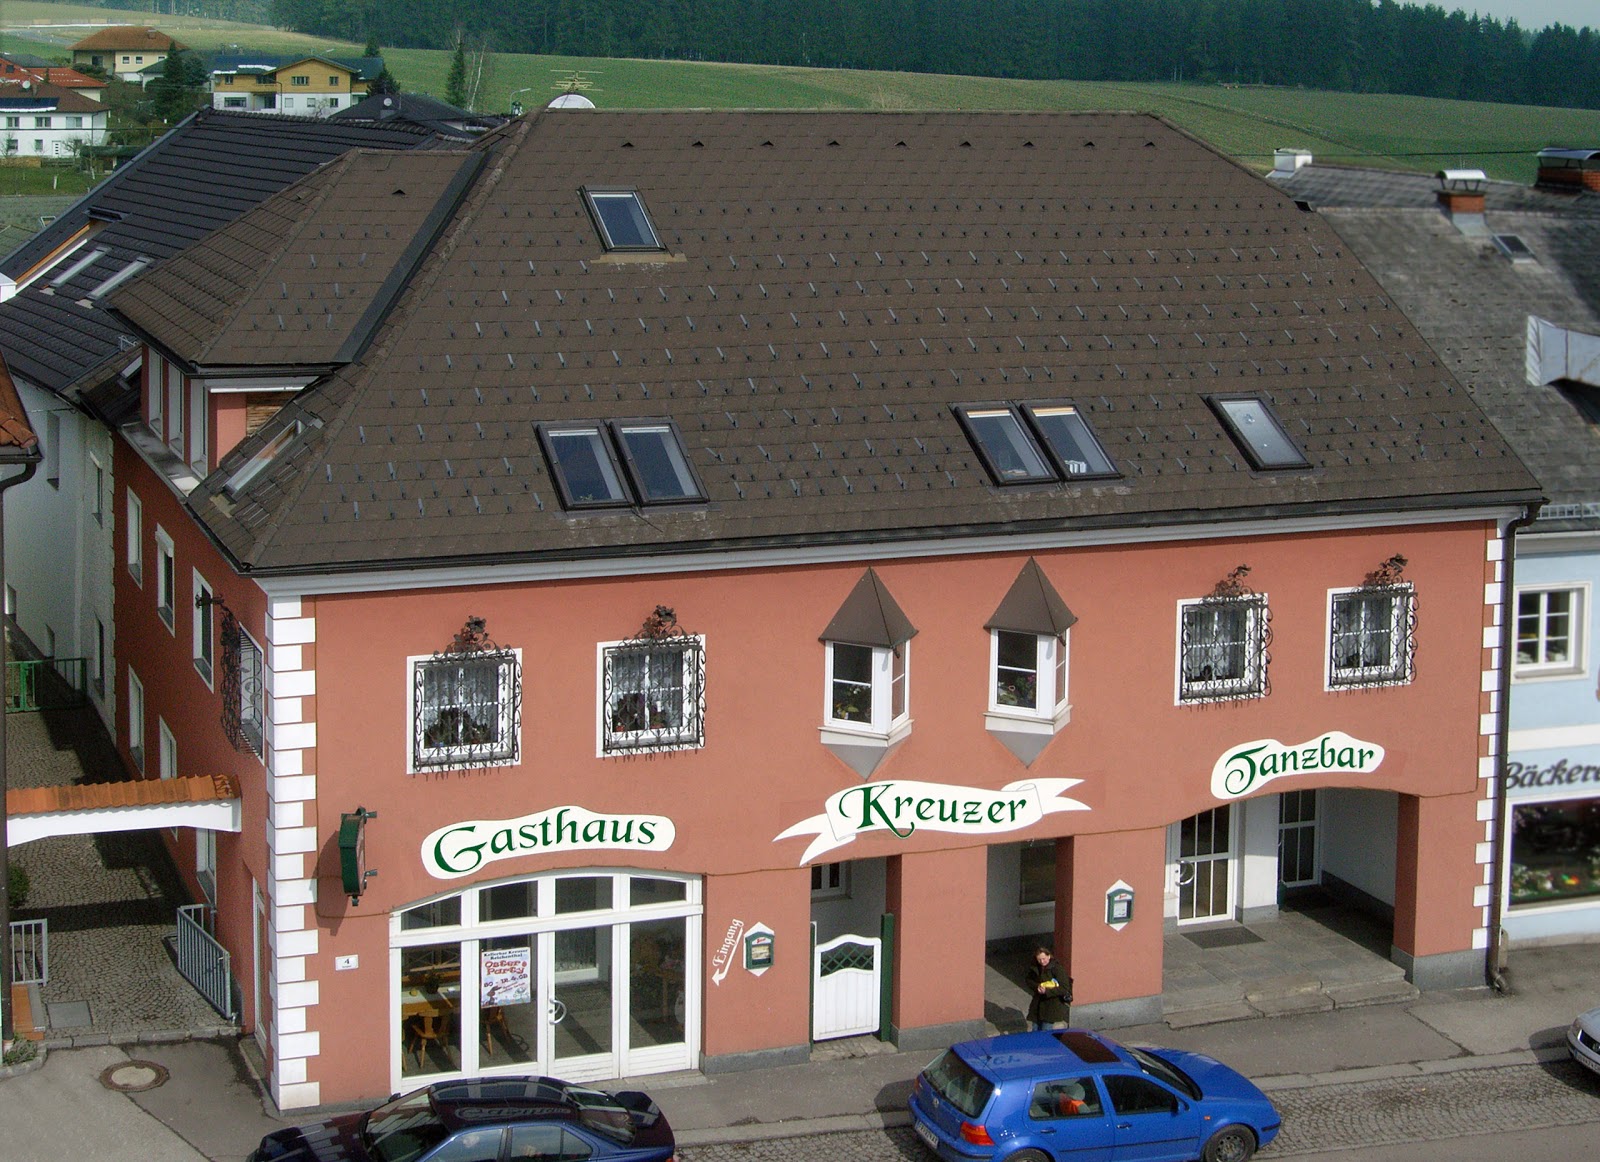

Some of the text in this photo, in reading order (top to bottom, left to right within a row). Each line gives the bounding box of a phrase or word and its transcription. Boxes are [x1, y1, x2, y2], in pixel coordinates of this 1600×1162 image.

[1225, 736, 1374, 795] Tanzbar
[838, 783, 1027, 839] Kreuzer
[433, 808, 658, 873] Gasthaus
[485, 960, 521, 968] Oster
[712, 918, 744, 967] Eingang
[487, 967, 524, 975] Party
